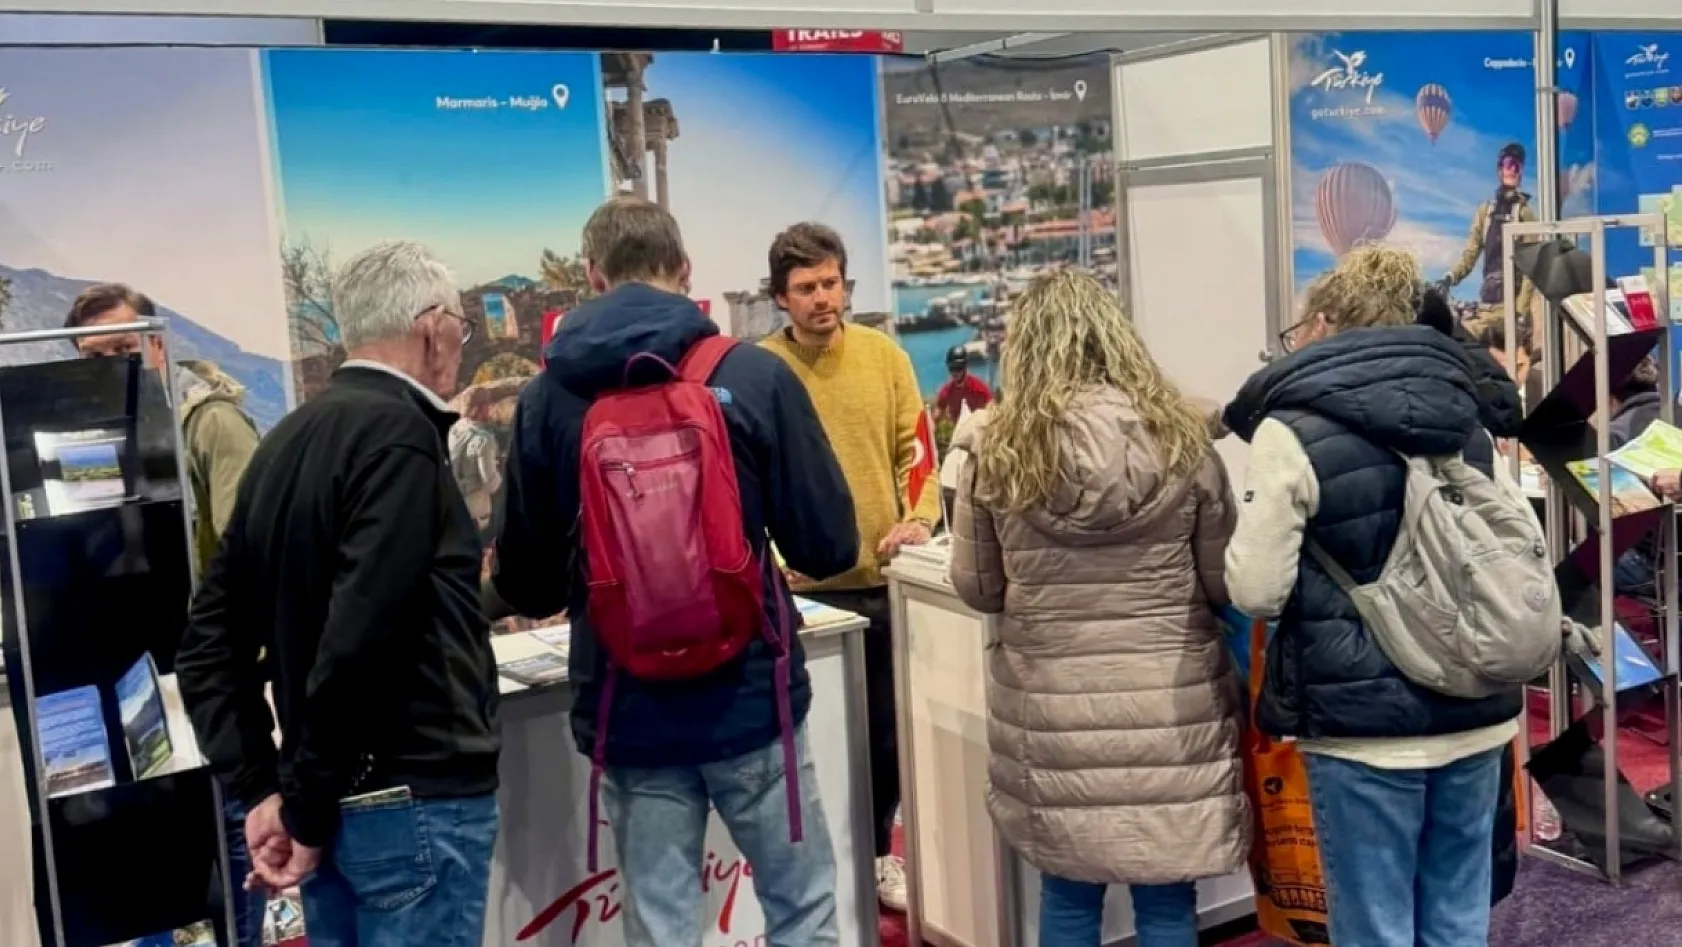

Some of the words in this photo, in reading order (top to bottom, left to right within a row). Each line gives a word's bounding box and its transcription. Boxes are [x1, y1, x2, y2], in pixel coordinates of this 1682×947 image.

[436, 95, 498, 109] Marmaris
[509, 95, 548, 111] Muğla
[949, 91, 1015, 103] Mediterranean
